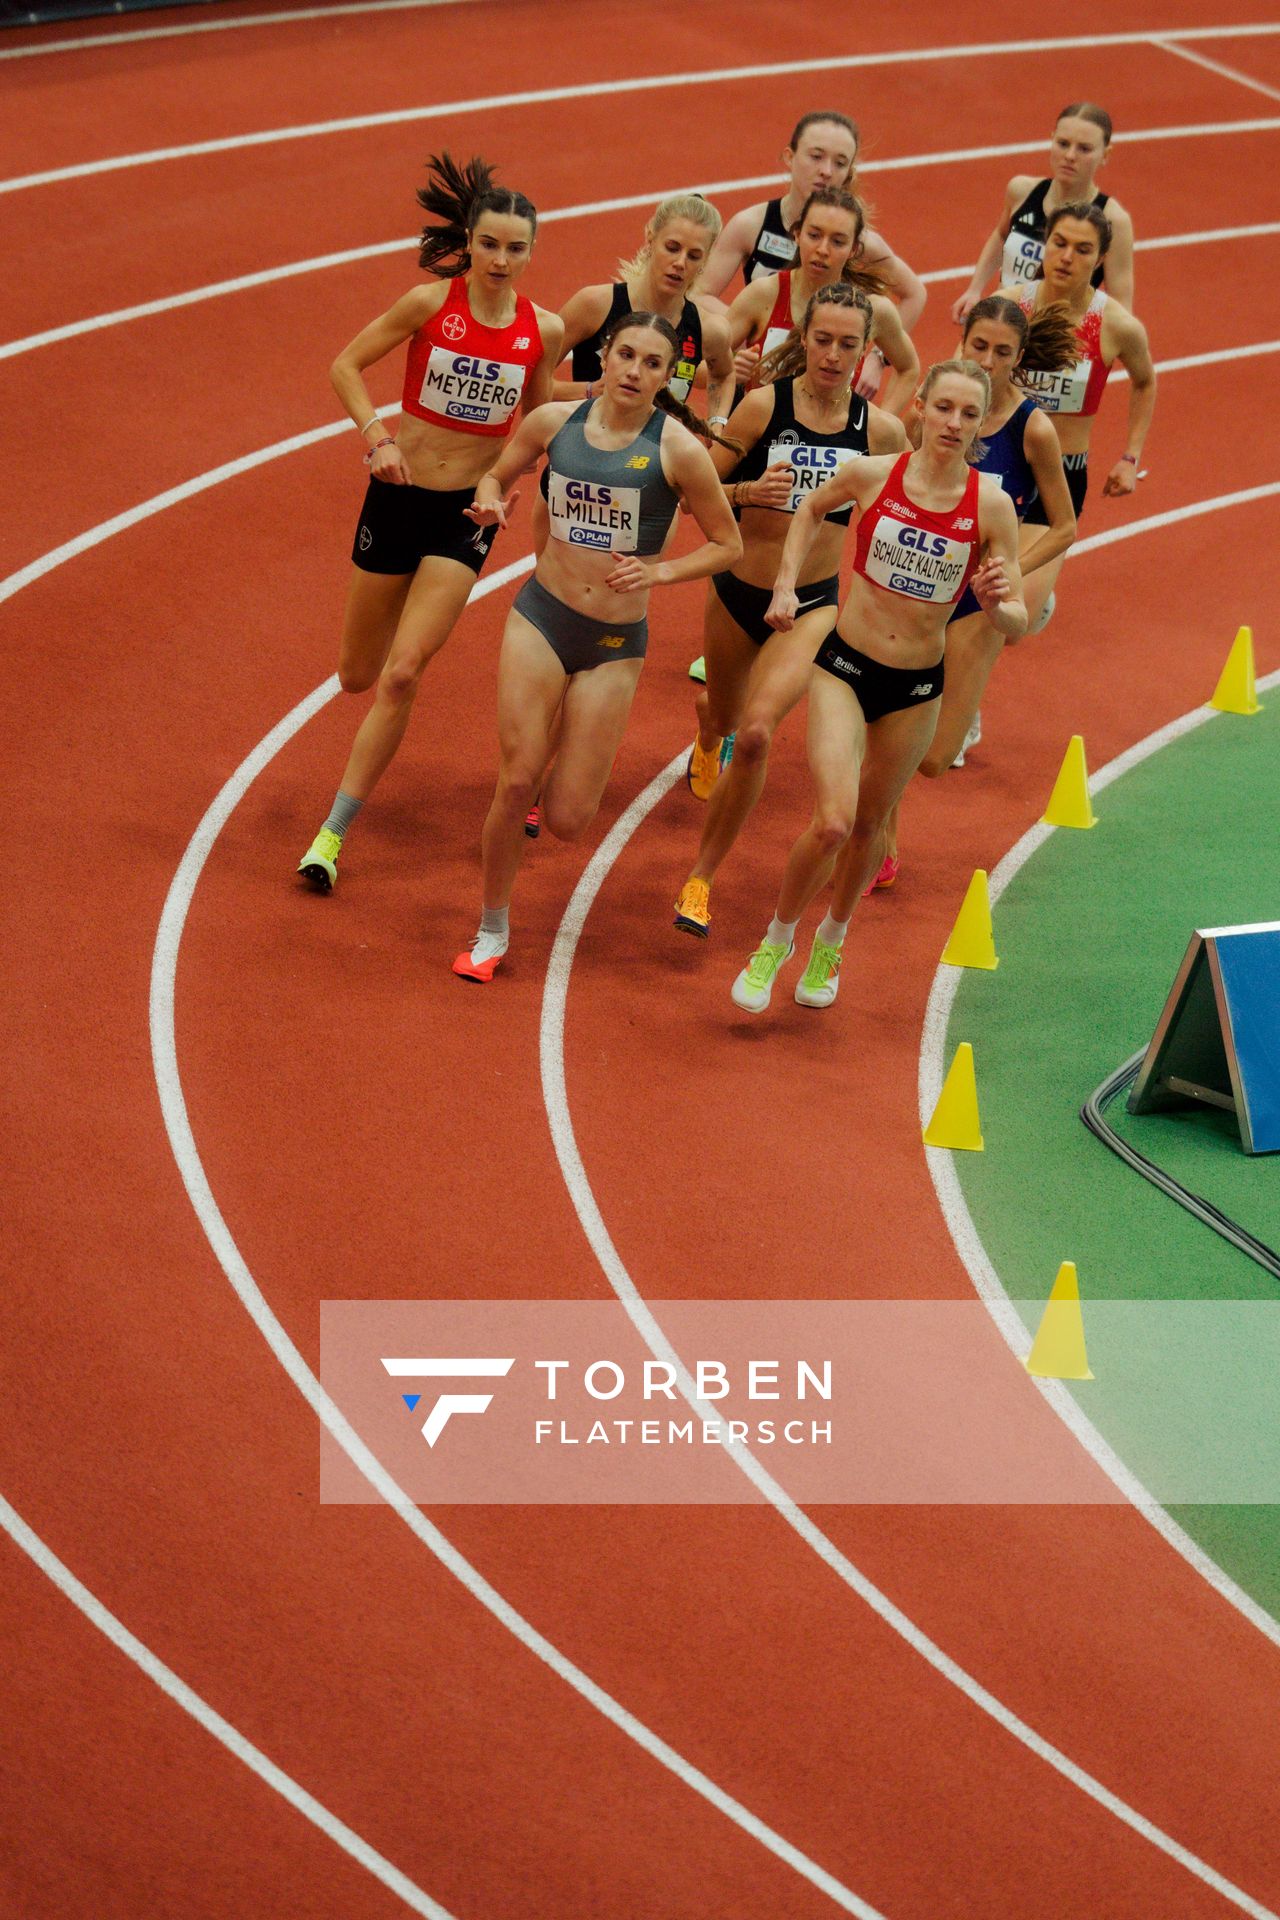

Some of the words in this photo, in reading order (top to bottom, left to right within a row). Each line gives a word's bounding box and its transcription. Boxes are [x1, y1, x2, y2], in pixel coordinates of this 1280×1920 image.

[426, 368, 518, 407] MEYBERG
[464, 406, 489, 417] PLAN
[551, 496, 632, 531] L.MILLER
[891, 502, 917, 520] Brillux
[586, 532, 611, 544] PLAN
[873, 539, 917, 572] SCHULZE
[915, 556, 963, 583] KALTHOFF
[908, 581, 934, 594] PLAN
[835, 655, 863, 676] Brillux
